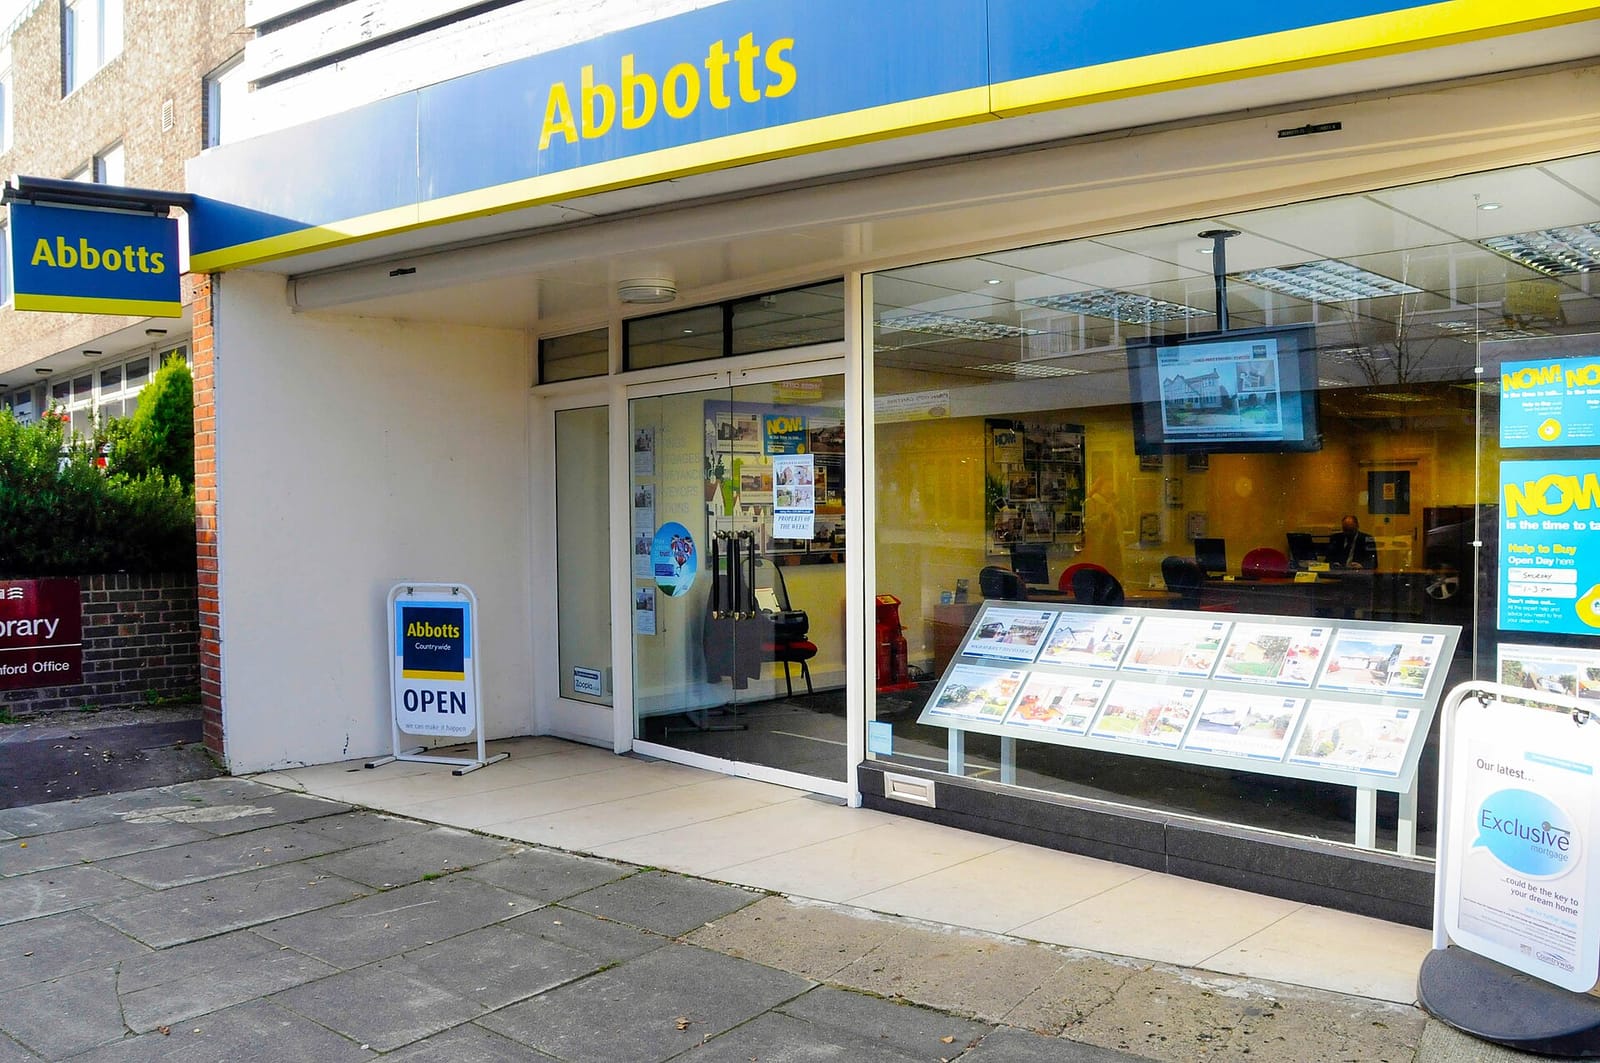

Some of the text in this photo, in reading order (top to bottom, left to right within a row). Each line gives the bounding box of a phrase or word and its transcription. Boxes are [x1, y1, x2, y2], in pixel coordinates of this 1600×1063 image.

[538, 31, 797, 150] Abbotts
[31, 236, 165, 274] Abbotts
[1502, 364, 1562, 391] NOW!
[1566, 365, 1600, 388] NO
[1519, 520, 1540, 530] the
[1542, 520, 1570, 530] time
[1573, 520, 1586, 531] to
[1508, 543, 1577, 556] Help to Buy
[1508, 556, 1533, 566] Open
[1535, 556, 1554, 567] Day
[407, 621, 460, 639] Abbotts
[414, 642, 451, 652] Countrywide
[32, 660, 70, 673] Office
[403, 688, 467, 714] OPEN
[1476, 758, 1494, 772] Our
[1481, 809, 1570, 851] Exclusive
[1530, 844, 1569, 862] mortgage
[1510, 888, 1578, 916] your dream home
[1527, 883, 1538, 893] be
[1539, 886, 1553, 898] the
[1554, 891, 1569, 904] key
[1570, 897, 1579, 907] to
